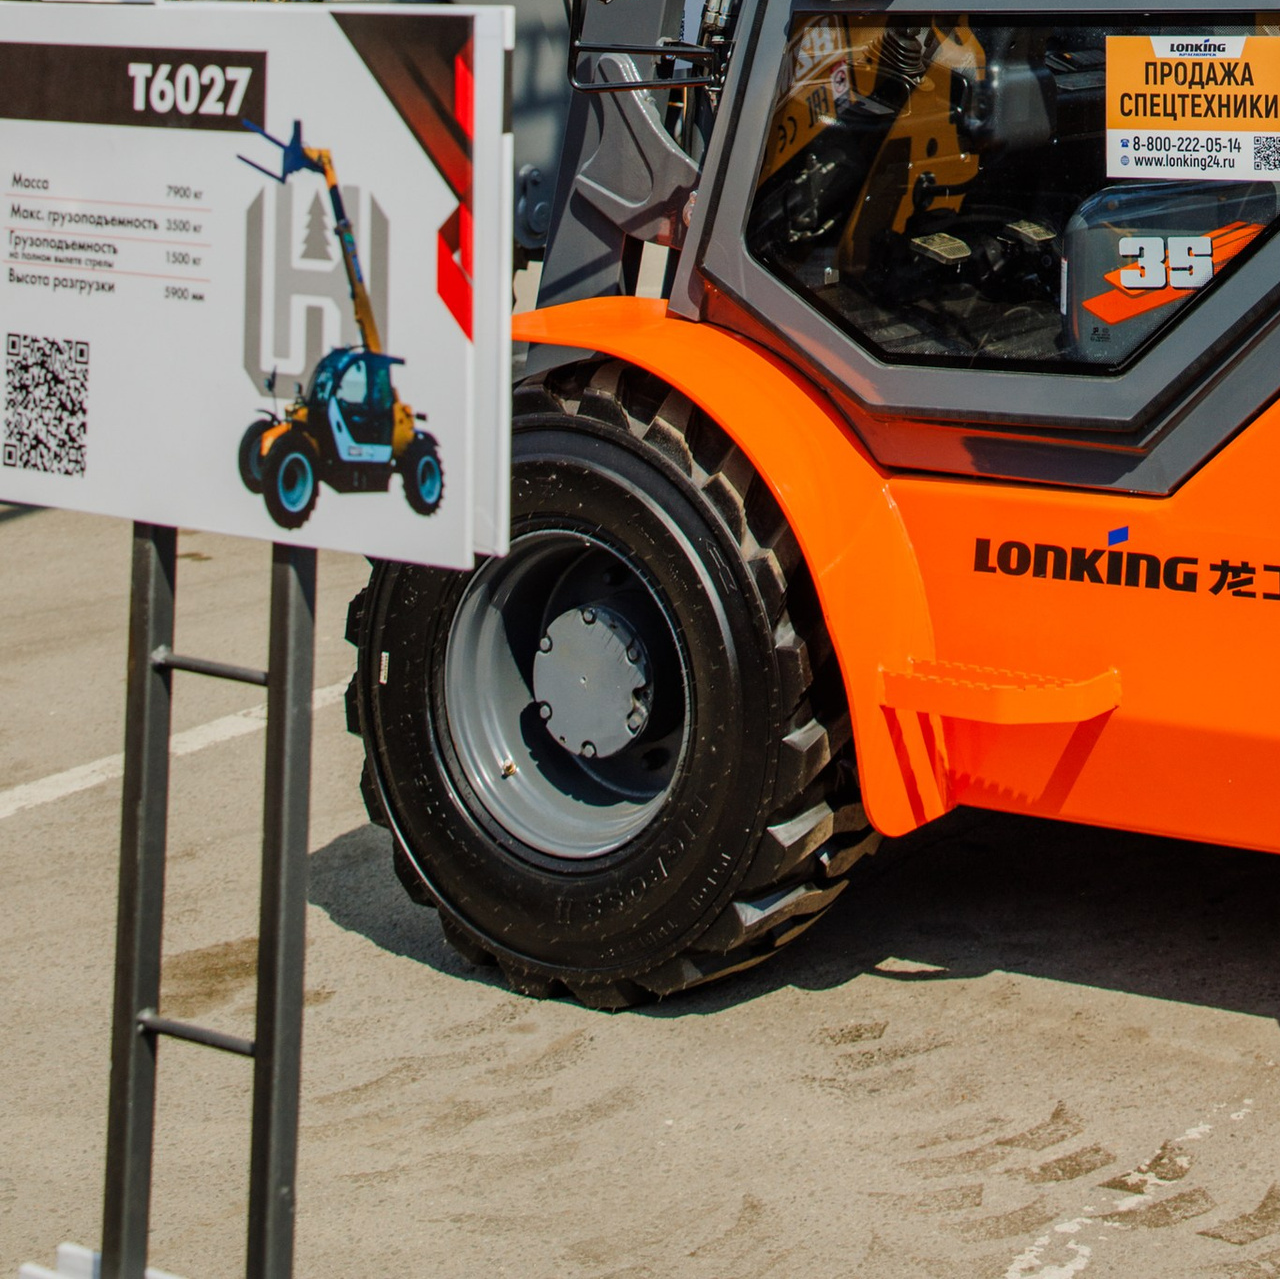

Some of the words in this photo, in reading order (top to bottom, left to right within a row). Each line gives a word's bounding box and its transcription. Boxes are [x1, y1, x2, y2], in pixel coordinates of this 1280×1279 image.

[1170, 38, 1226, 52] LONKING
[127, 63, 253, 117] T6027
[1144, 61, 1255, 90] ПРОДАЖА
[1119, 92, 1279, 121] СПЕЦТЕХНИКИ
[1132, 136, 1242, 153] 8-800-222-05-14
[1133, 153, 1236, 171] www.lonking24.ru
[12, 172, 49, 190] Масса
[166, 185, 192, 199] 7900
[194, 190, 203, 200] кг
[10, 204, 45, 221] Макс.
[47, 210, 159, 231] грузоподъемность
[166, 218, 191, 233] 3500
[192, 224, 202, 233] кг
[8, 230, 119, 255] Грузоподъемность
[165, 251, 191, 266] 1500
[191, 256, 201, 266] кг
[1118, 236, 1215, 289] 35
[8, 268, 50, 287] Высота
[53, 277, 116, 296] разгрузки
[164, 286, 189, 301] 5900
[974, 525, 1199, 593] LONKING
